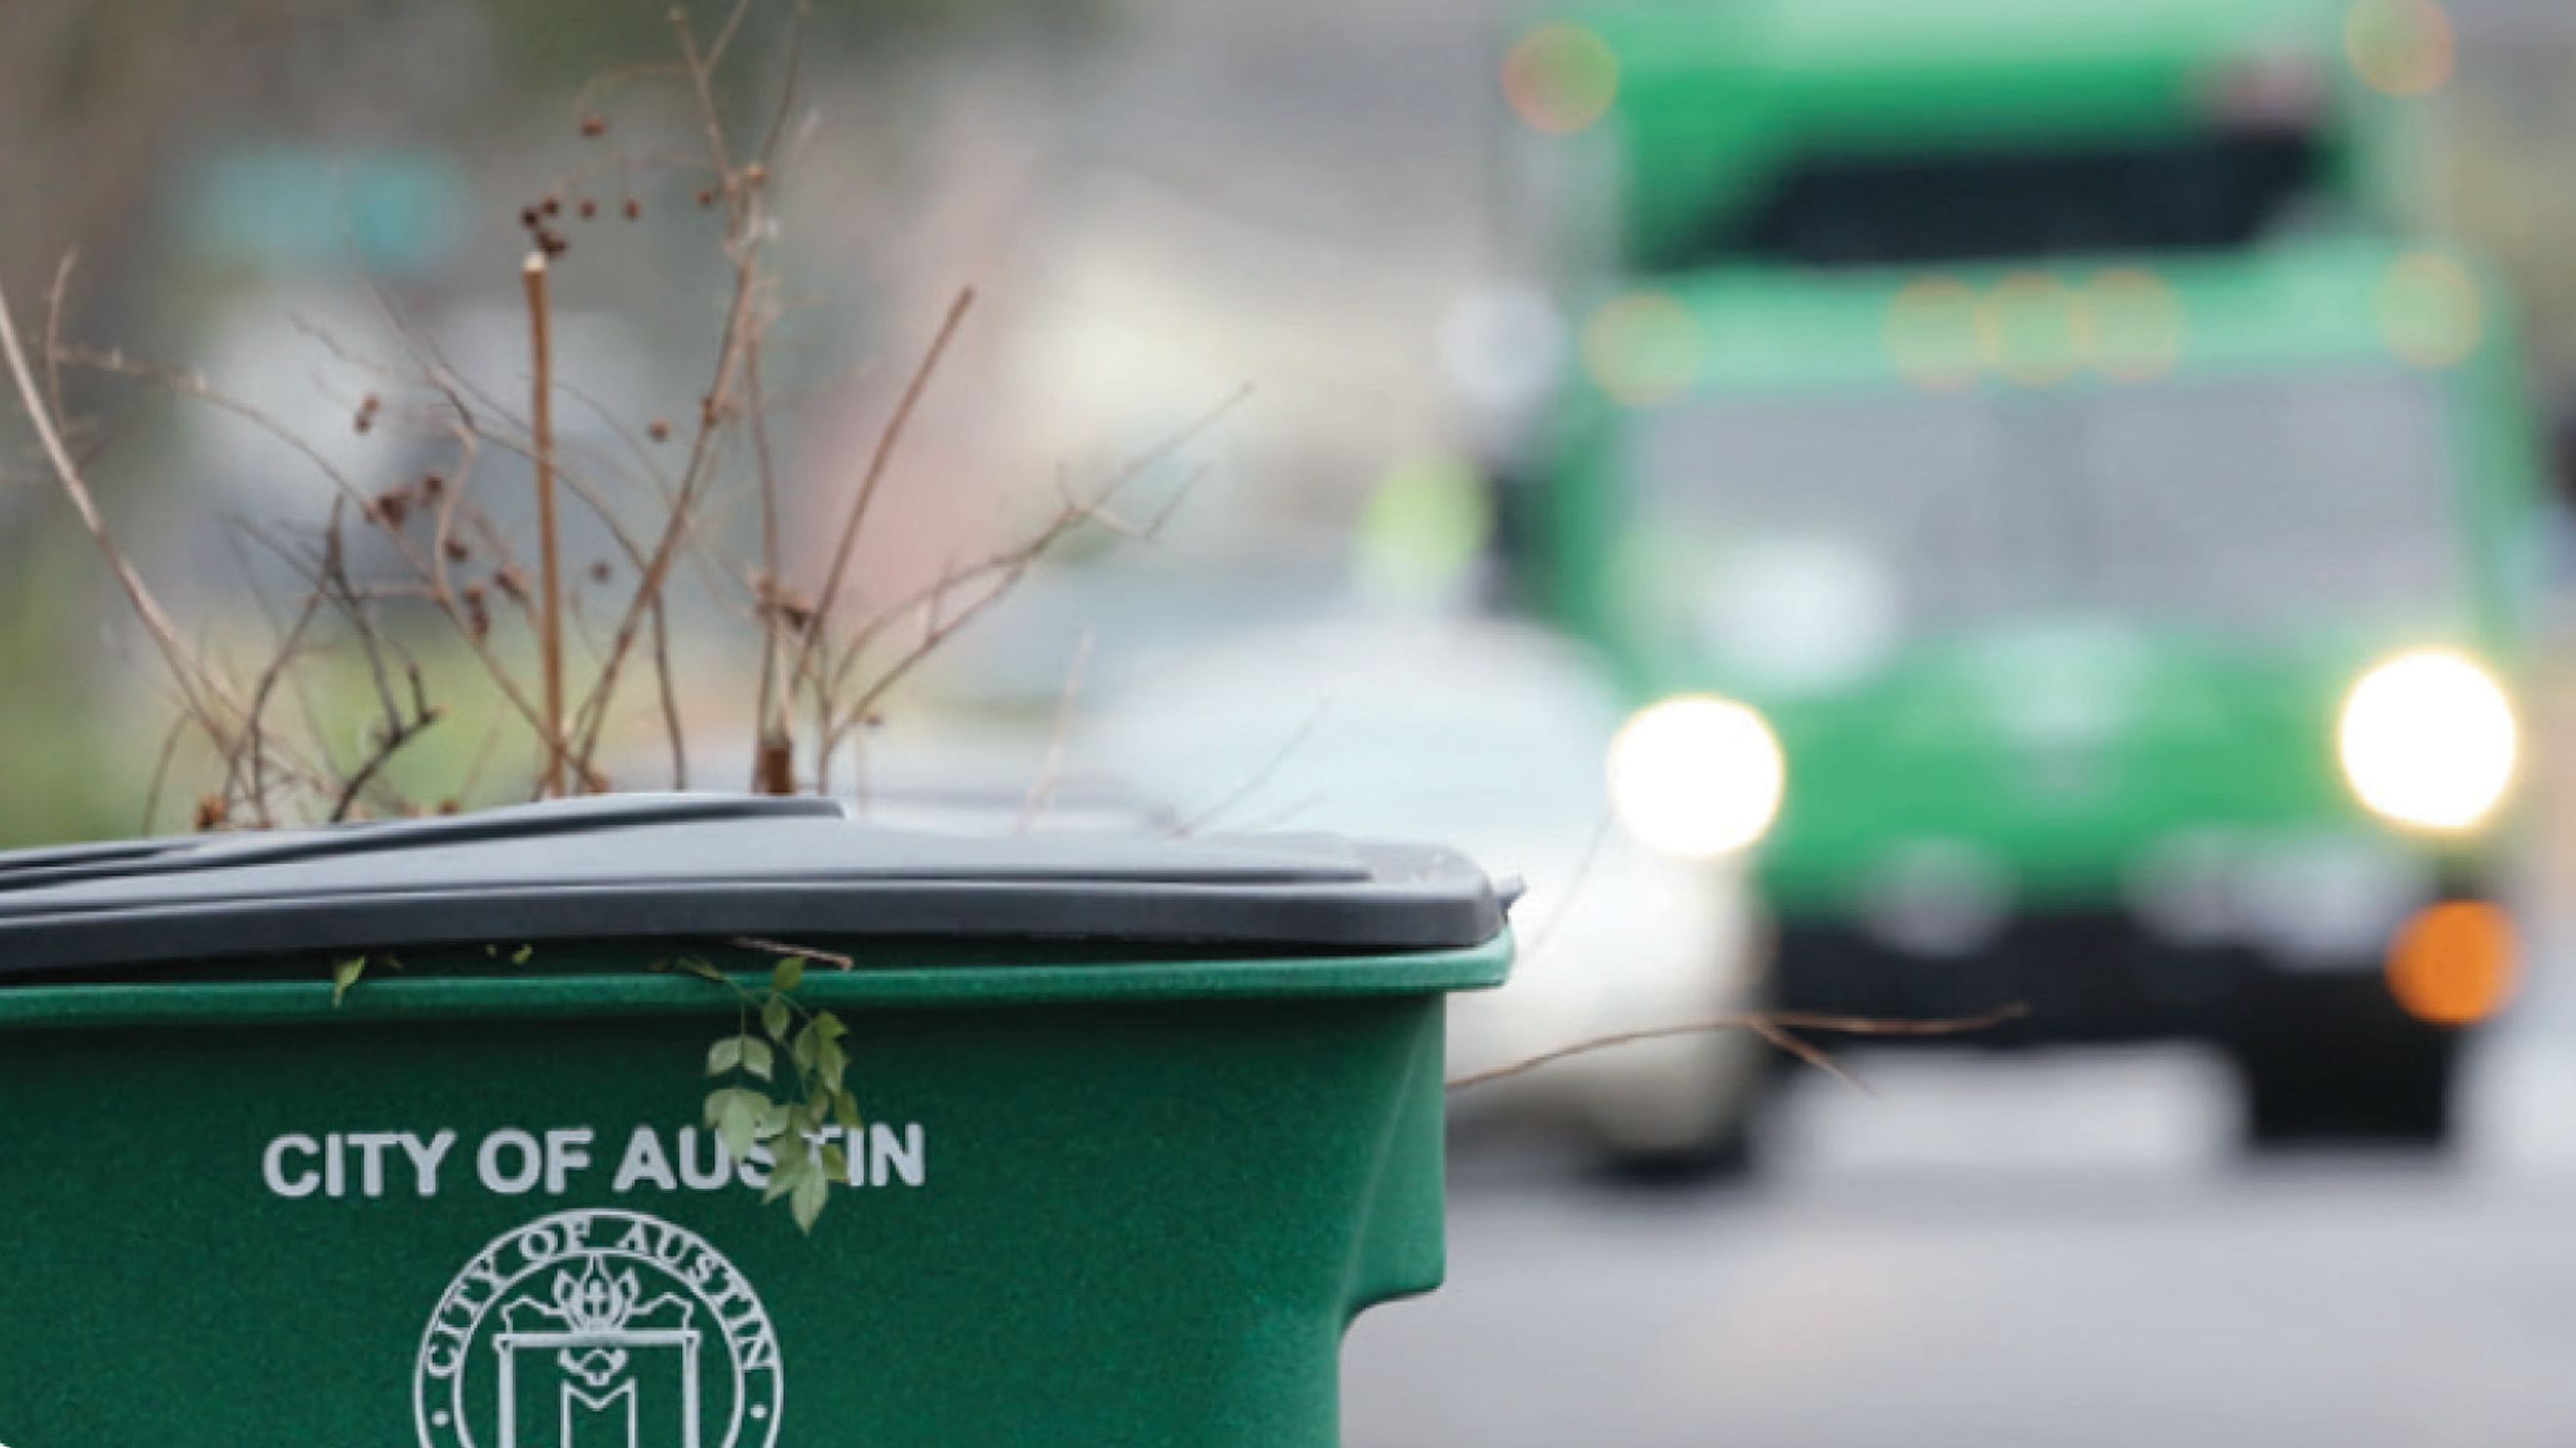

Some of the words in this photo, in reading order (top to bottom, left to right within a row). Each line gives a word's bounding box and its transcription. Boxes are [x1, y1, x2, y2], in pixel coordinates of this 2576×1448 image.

[262, 1129, 457, 1199] CITY
[477, 1126, 595, 1195] OF
[426, 1251, 511, 1378] CITY
[519, 1217, 590, 1261] OF
[617, 1219, 777, 1371] AUSTIN
